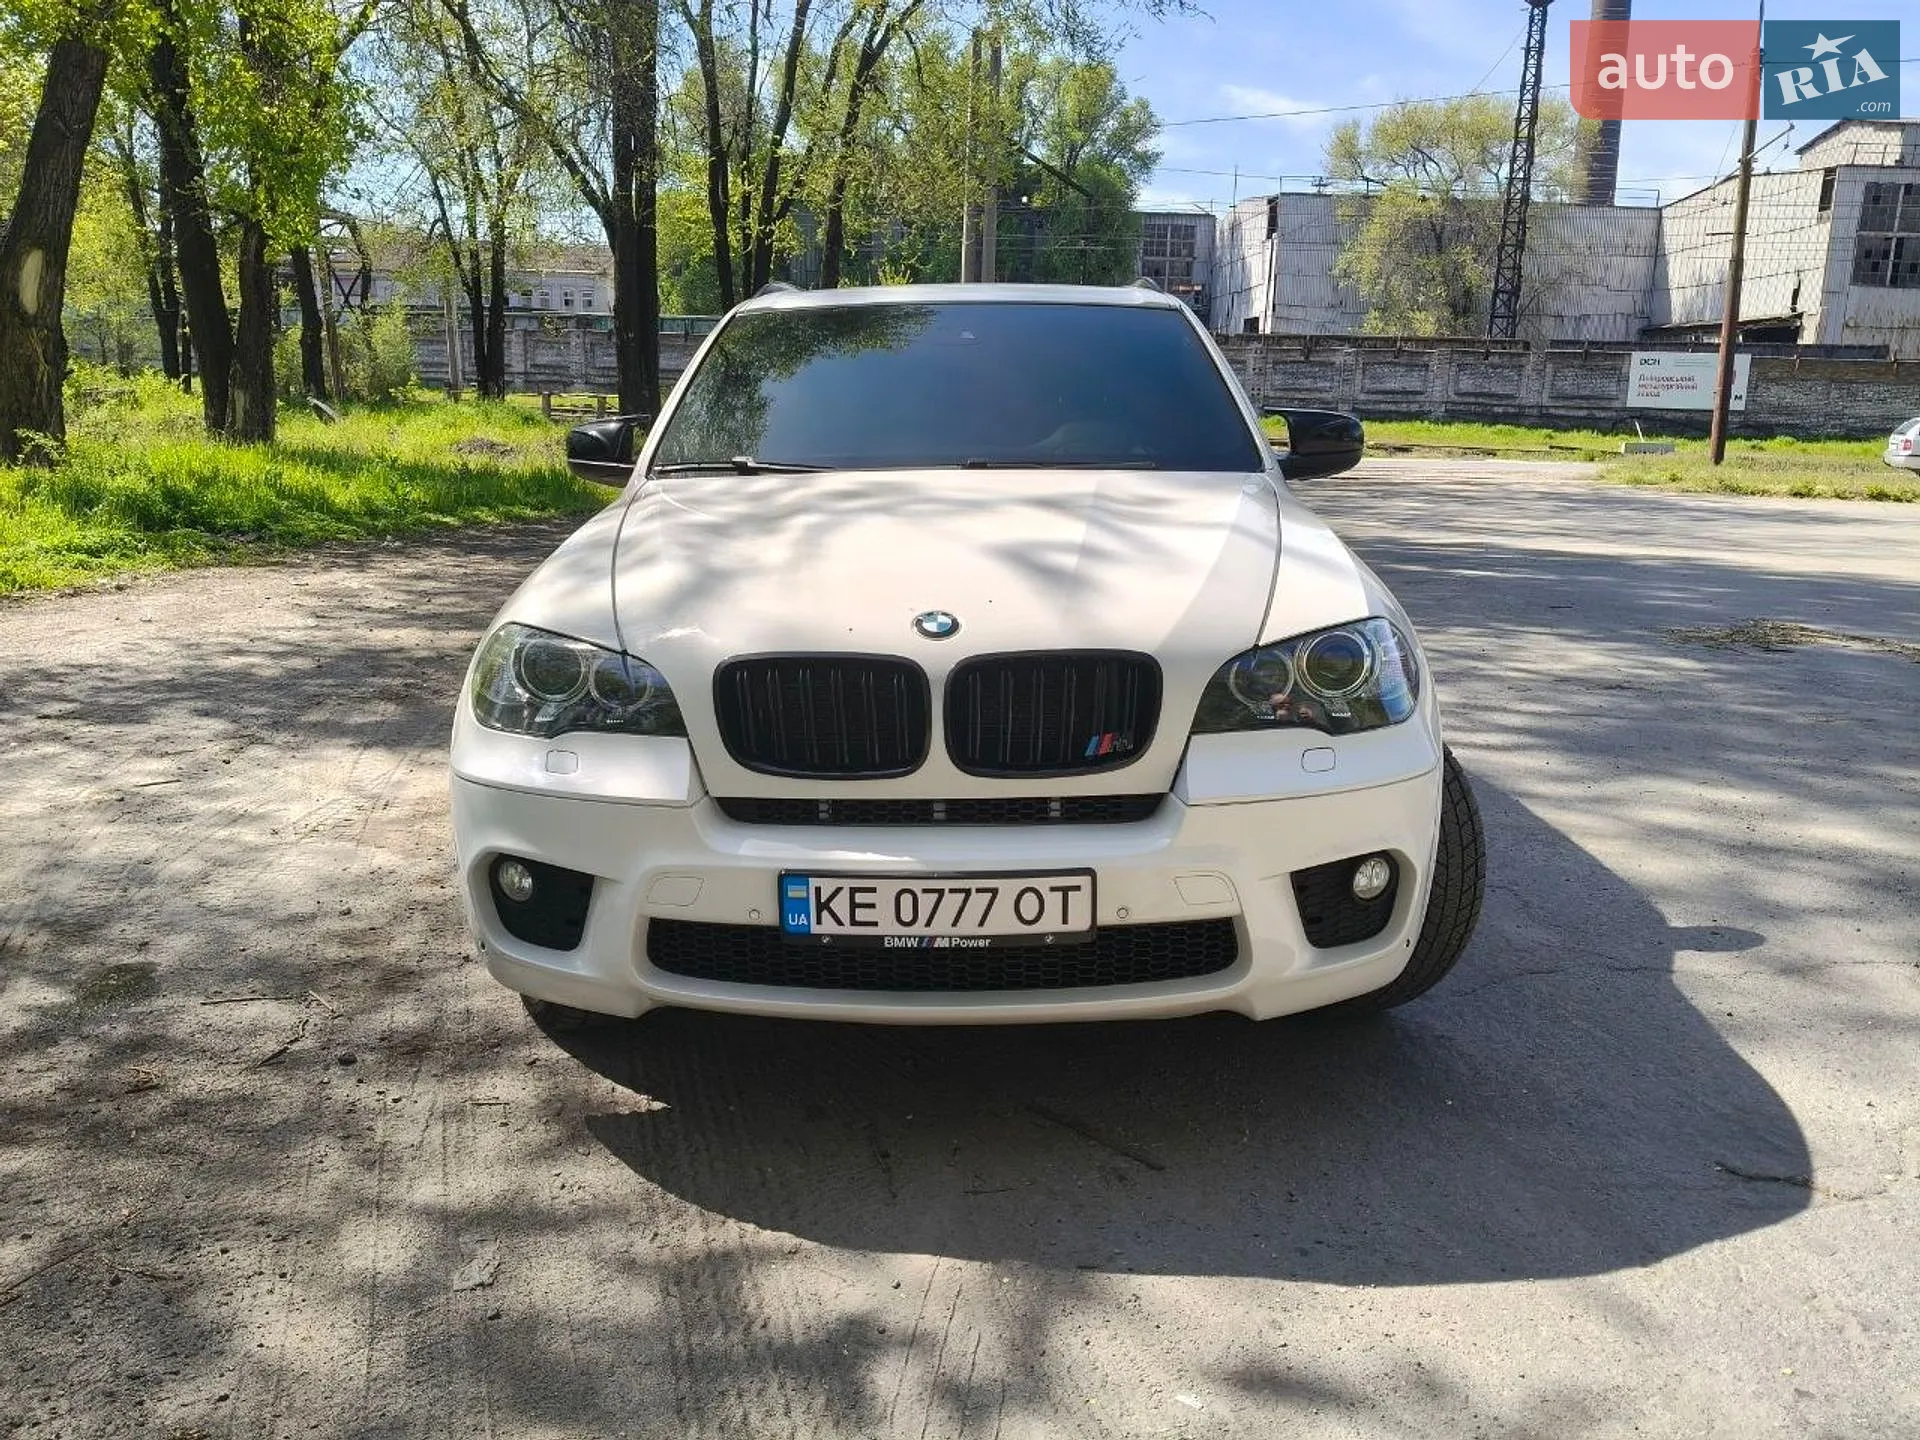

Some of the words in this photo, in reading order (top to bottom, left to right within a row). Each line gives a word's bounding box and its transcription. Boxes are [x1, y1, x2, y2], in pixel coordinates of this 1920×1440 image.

[813, 885, 880, 928] KE
[893, 886, 1000, 928] 0777
[1013, 884, 1082, 927] OT
[788, 913, 808, 926] UA
[884, 936, 919, 948] BMW
